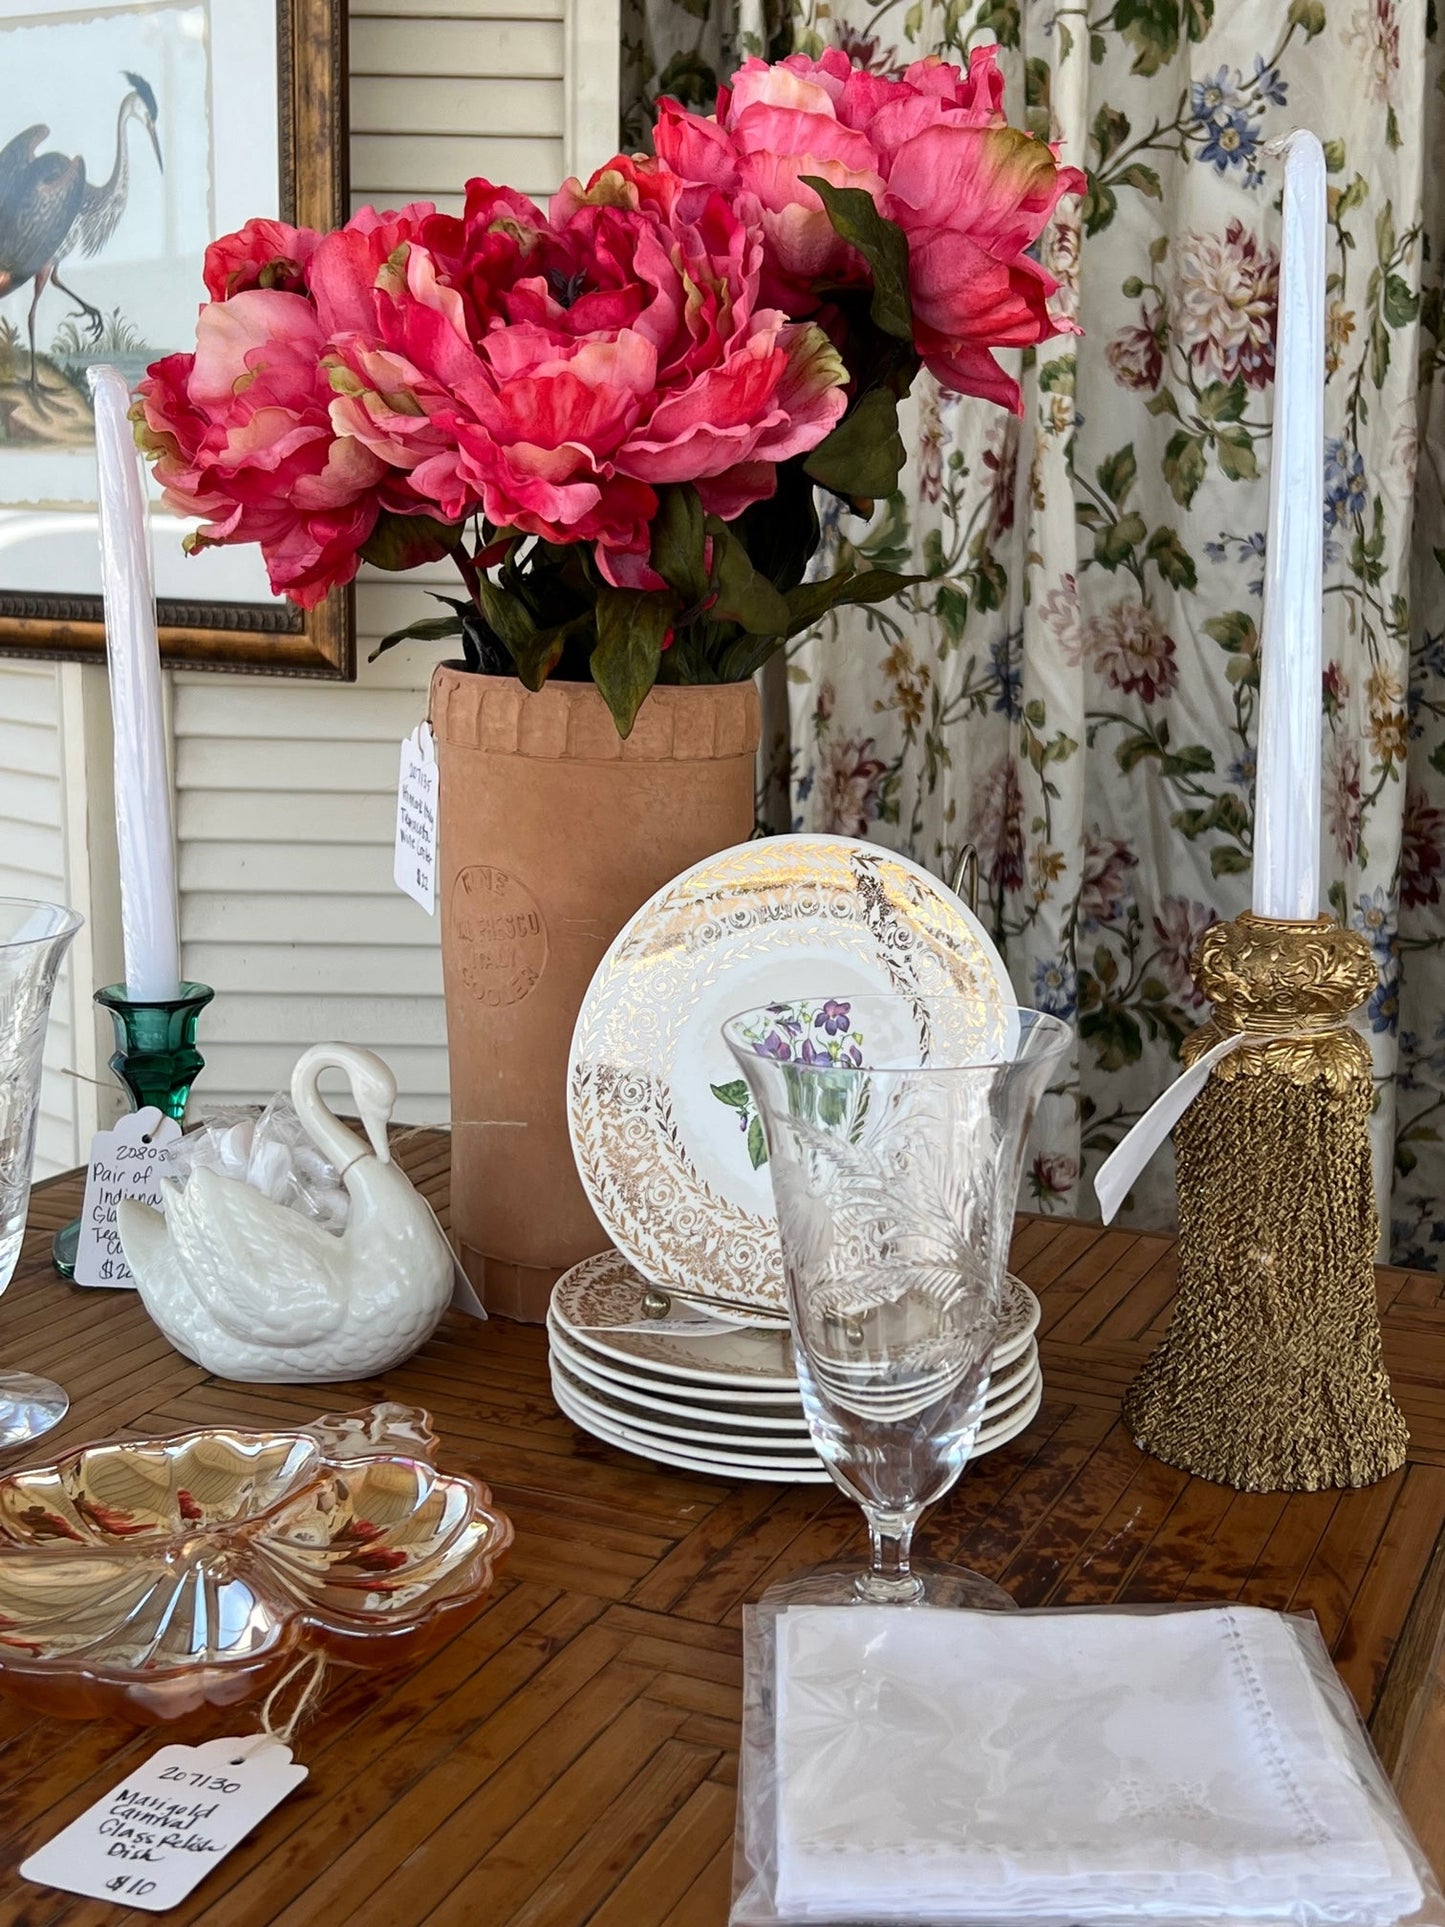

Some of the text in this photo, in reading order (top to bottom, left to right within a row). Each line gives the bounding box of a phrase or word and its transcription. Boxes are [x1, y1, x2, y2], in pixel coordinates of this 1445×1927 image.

[93, 1162, 153, 1184] Pair of
[157, 1766, 242, 1794] 207130
[109, 1804, 198, 1831] Carnival
[114, 1789, 220, 1820] Marigold
[99, 1818, 228, 1853] Glass Relish
[106, 1841, 165, 1862] Dish
[105, 1875, 157, 1897] $10
